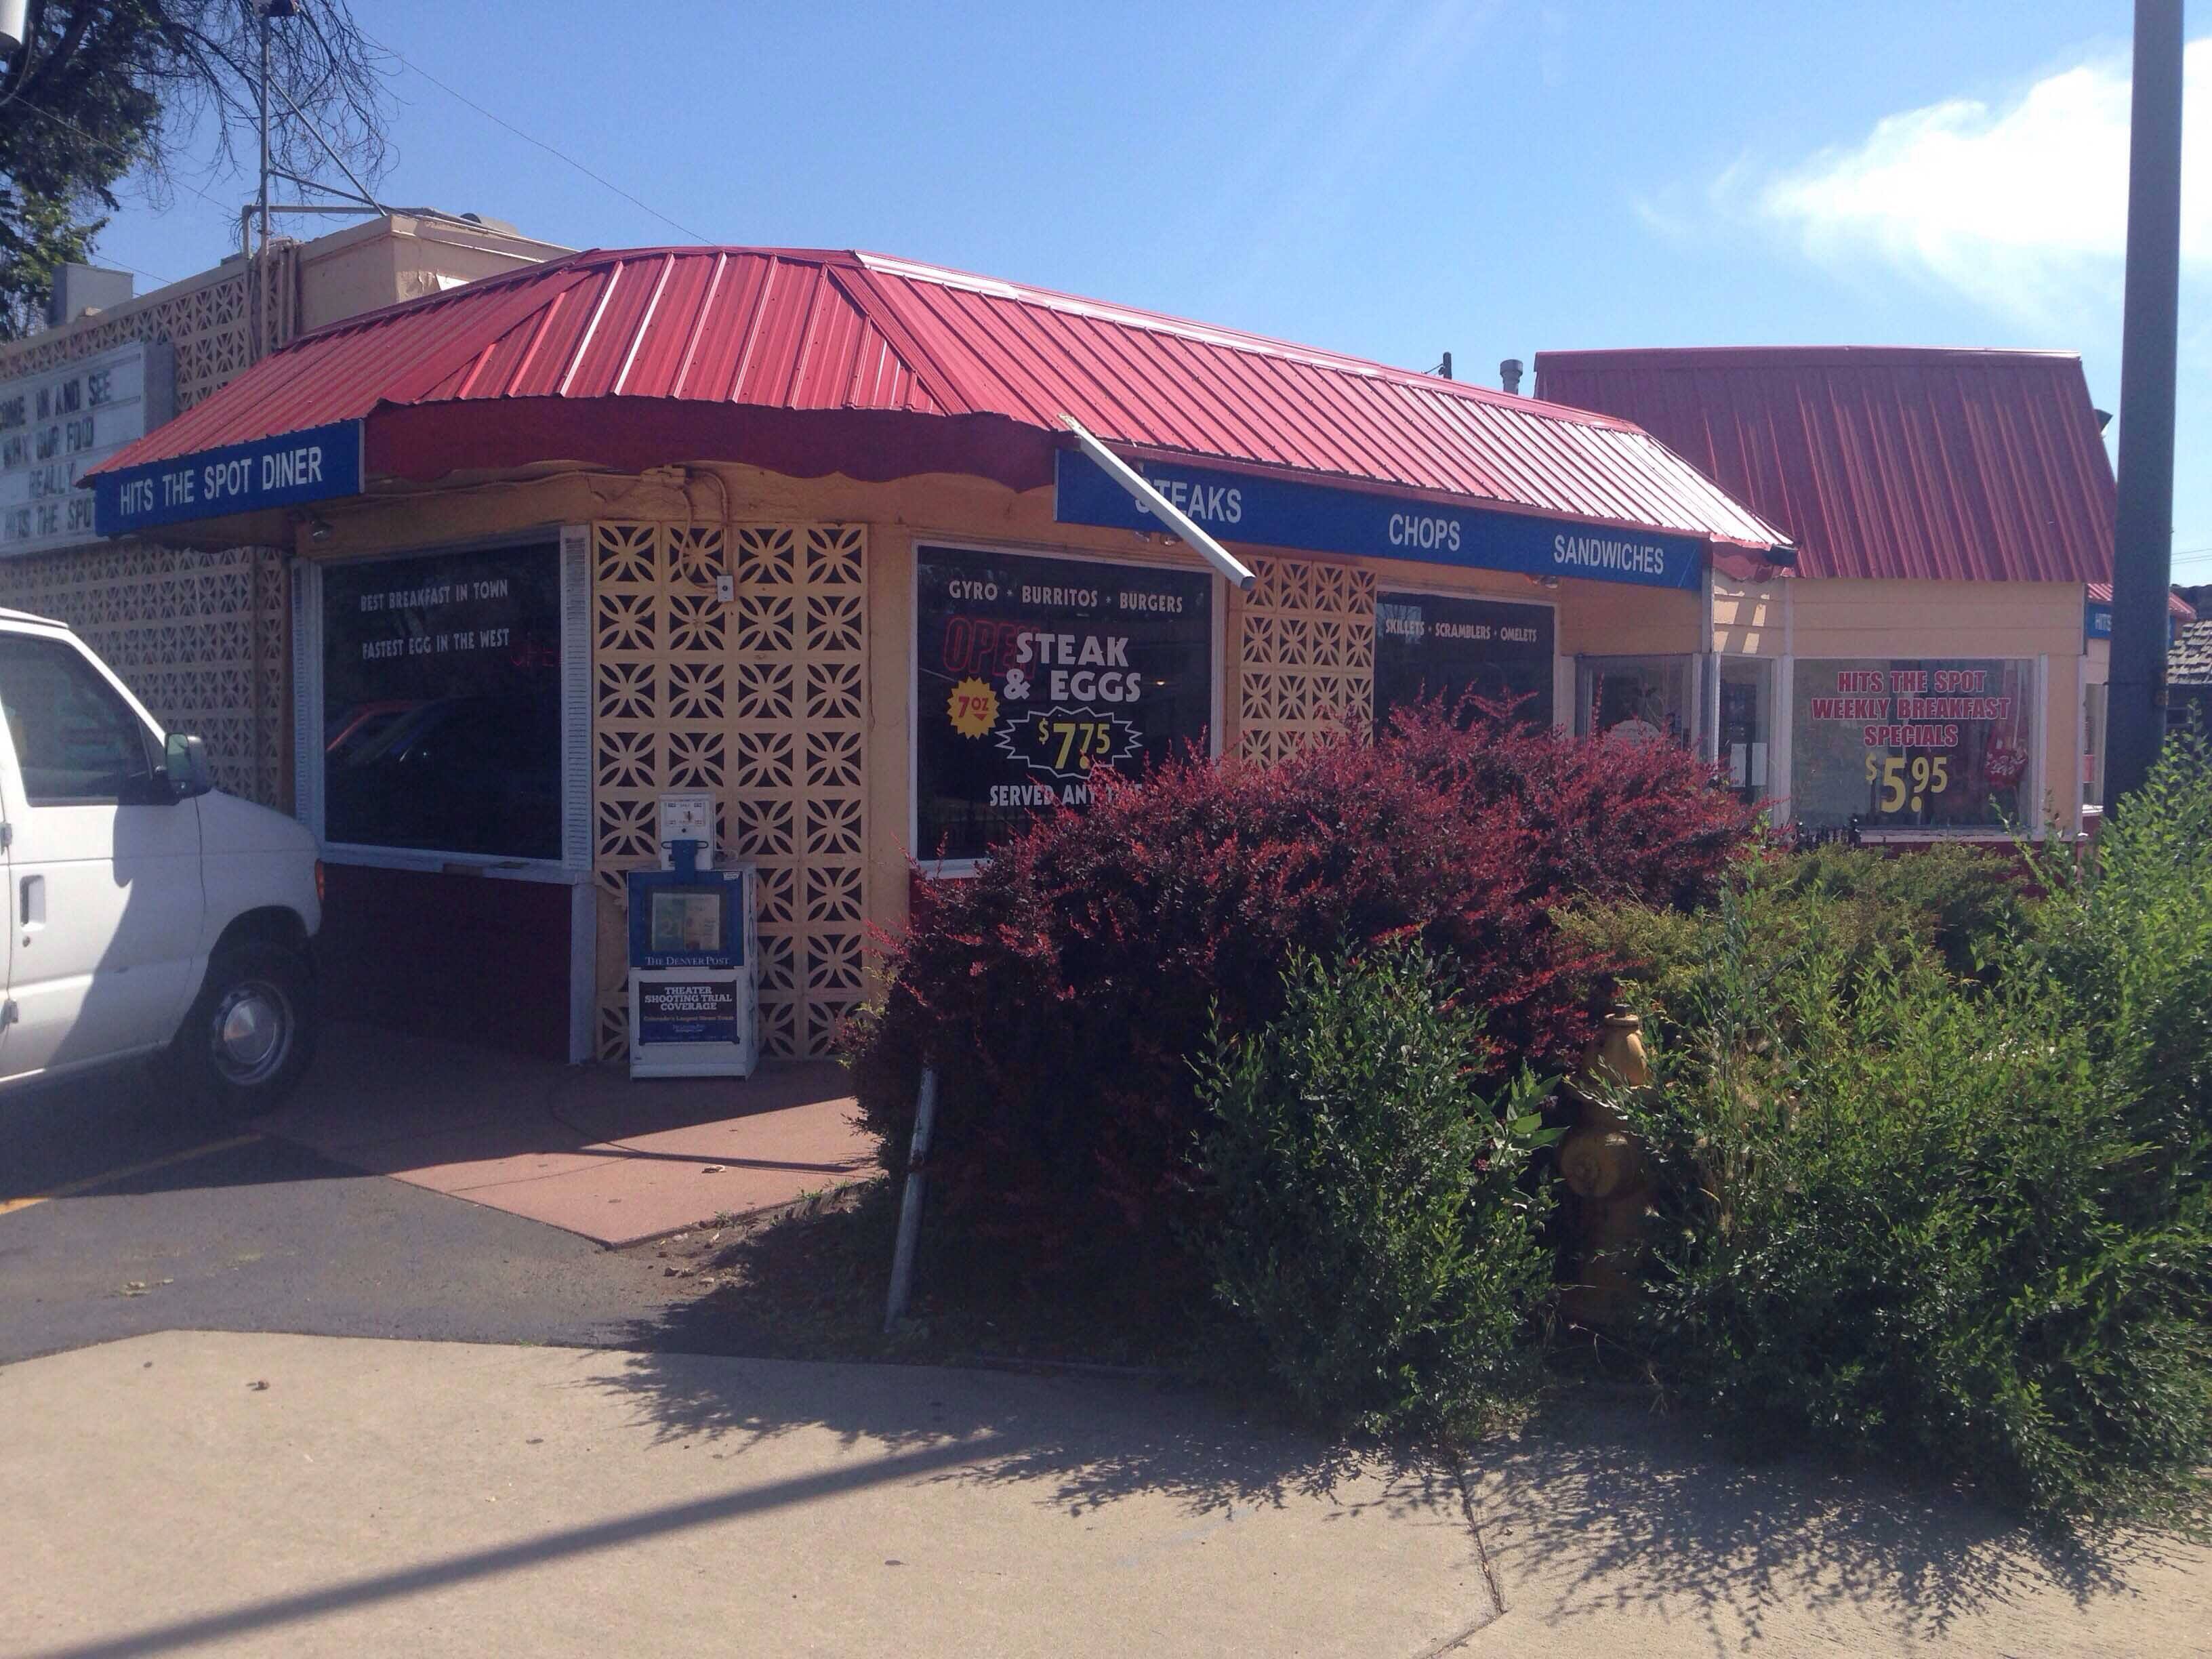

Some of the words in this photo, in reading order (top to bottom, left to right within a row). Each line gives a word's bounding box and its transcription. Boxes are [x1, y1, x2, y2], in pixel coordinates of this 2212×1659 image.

[0, 395, 25, 430] OME
[56, 380, 80, 416] AND
[88, 370, 110, 407] SEE
[66, 417, 94, 453] FOOD
[120, 478, 153, 515] HITS
[163, 469, 194, 506] THE
[204, 457, 251, 499] SPOT
[262, 446, 323, 490] DINER
[68, 498, 94, 530] SPO
[1389, 514, 1461, 552] CHOPS
[1554, 534, 1664, 575] SANDWICHES
[361, 594, 384, 611] BEST
[390, 586, 450, 609] BREAKFAST
[456, 583, 468, 602] IN
[474, 579, 508, 600] TOWN
[949, 580, 998, 601] GYRO
[1022, 585, 1098, 607] BURRITOS
[1120, 592, 1183, 613] BURGERS
[363, 639, 403, 659] FASTEST
[409, 636, 431, 655] EGG
[436, 634, 447, 652] IN
[454, 632, 474, 650] THE
[480, 628, 509, 648] WEST
[1385, 617, 1425, 636] SKILLETS
[1435, 622, 1490, 640] SCRAMBLERS
[1500, 627, 1537, 642] OMELETS
[1017, 632, 1129, 667] STEAK
[1004, 668, 1030, 699] &
[1050, 670, 1141, 703] EGGS
[1837, 671, 1883, 693] HITS
[1890, 670, 1928, 693] THE
[1934, 670, 1986, 693] SPOT
[1811, 698, 1890, 720] WEEKLY
[1898, 697, 2011, 720] BREAKFAST
[1864, 724, 1958, 747] SPECIALS
[989, 785, 1054, 806] SERVED
[645, 956, 663, 966] THE
[666, 956, 705, 966] DENVER
[706, 956, 729, 965] POST
[644, 995, 699, 1003] SHOOTING
[701, 994, 733, 1002] TRIAL
[661, 1002, 717, 1010] COVERAGE
[665, 986, 712, 995] THEATER
